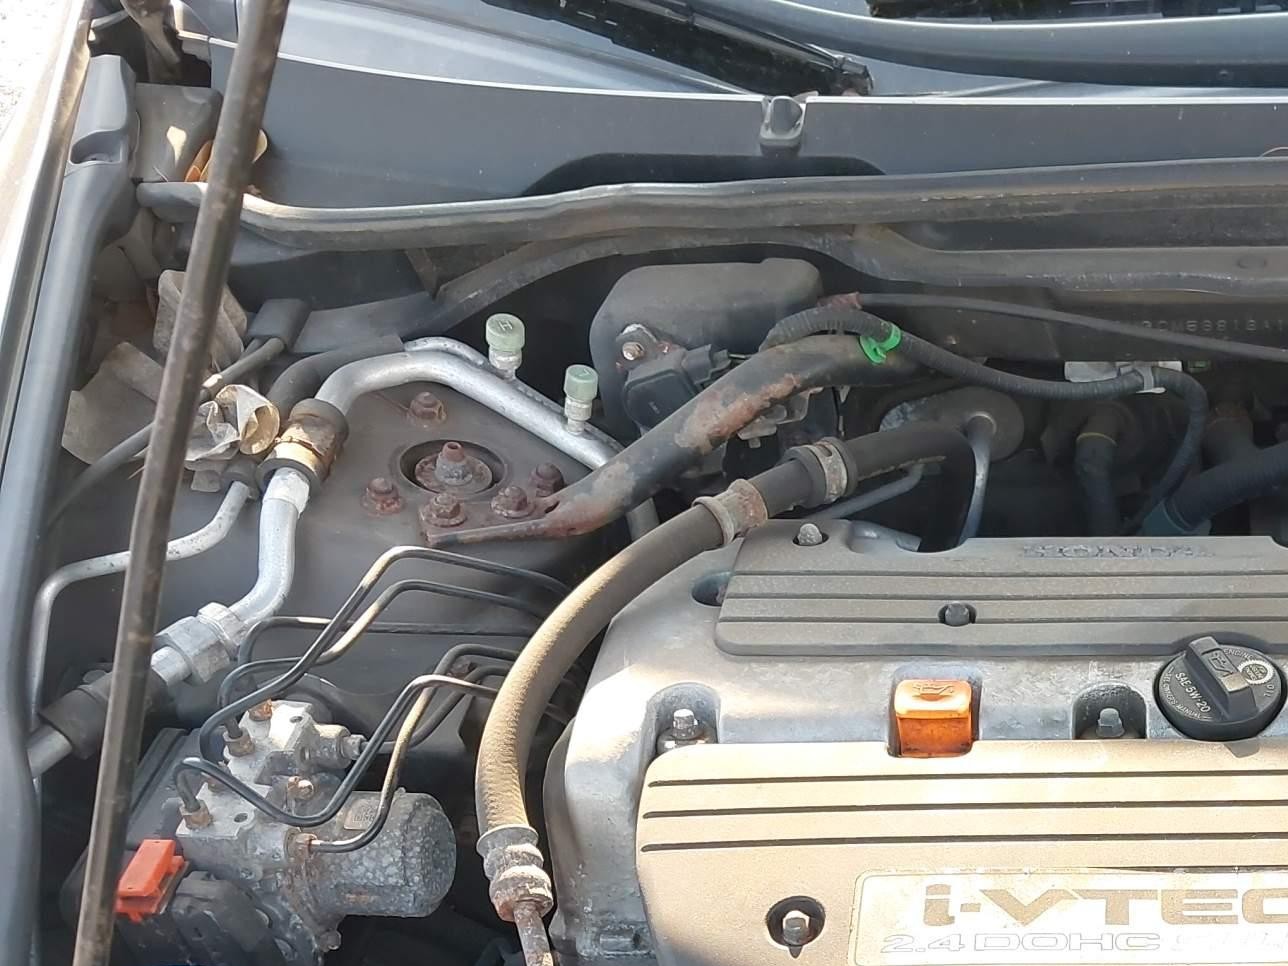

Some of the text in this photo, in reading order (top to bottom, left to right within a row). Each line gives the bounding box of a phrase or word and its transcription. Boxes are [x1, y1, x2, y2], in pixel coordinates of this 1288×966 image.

[1175, 671, 1192, 688] SAE
[880, 933, 966, 954] 2.4
[974, 931, 1161, 953] DOHC
